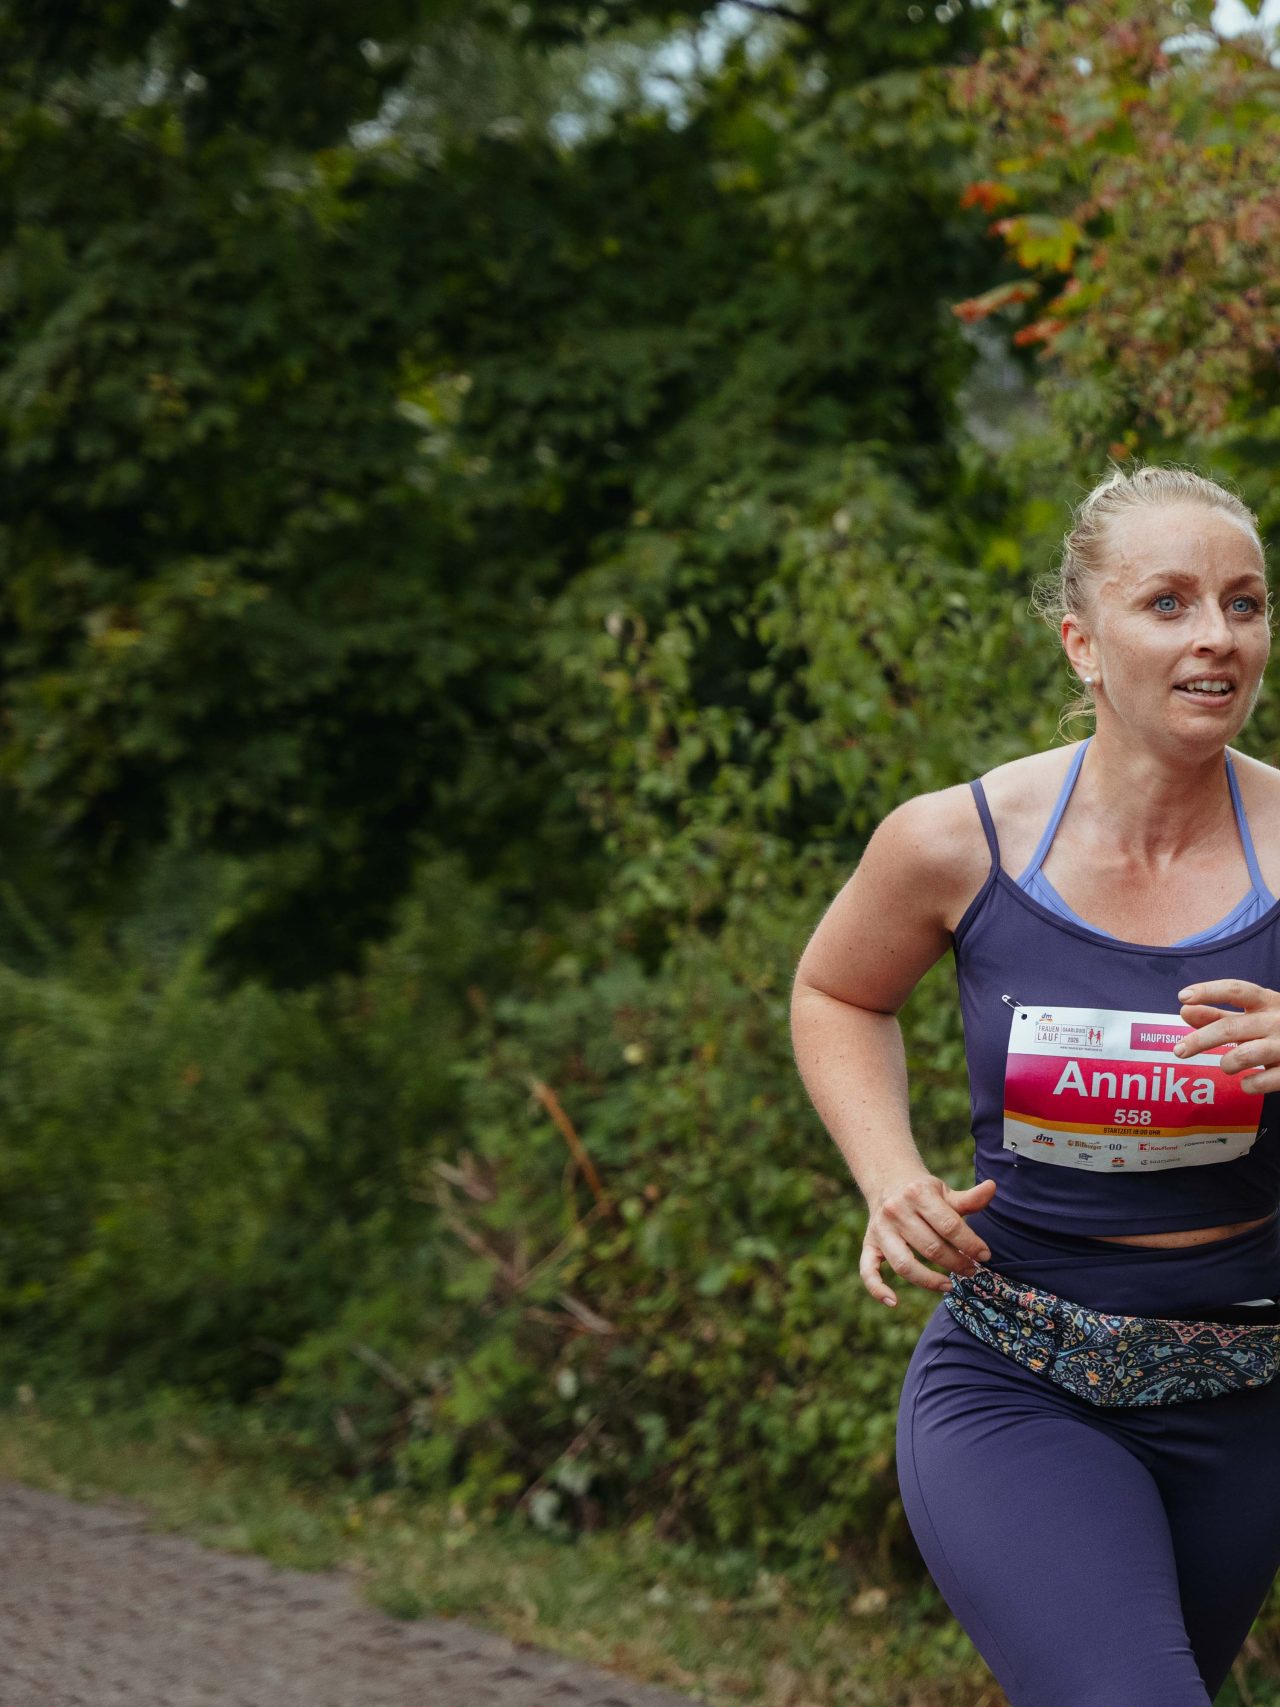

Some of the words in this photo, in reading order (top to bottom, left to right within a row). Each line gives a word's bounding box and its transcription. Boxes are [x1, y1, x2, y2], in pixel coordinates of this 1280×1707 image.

[1037, 1033, 1059, 1042] LAUF
[1052, 1060, 1215, 1105] Annika
[1114, 1109, 1152, 1125] 558
[1103, 1127, 1132, 1135] STARTZEIT
[1035, 1133, 1054, 1143] dm
